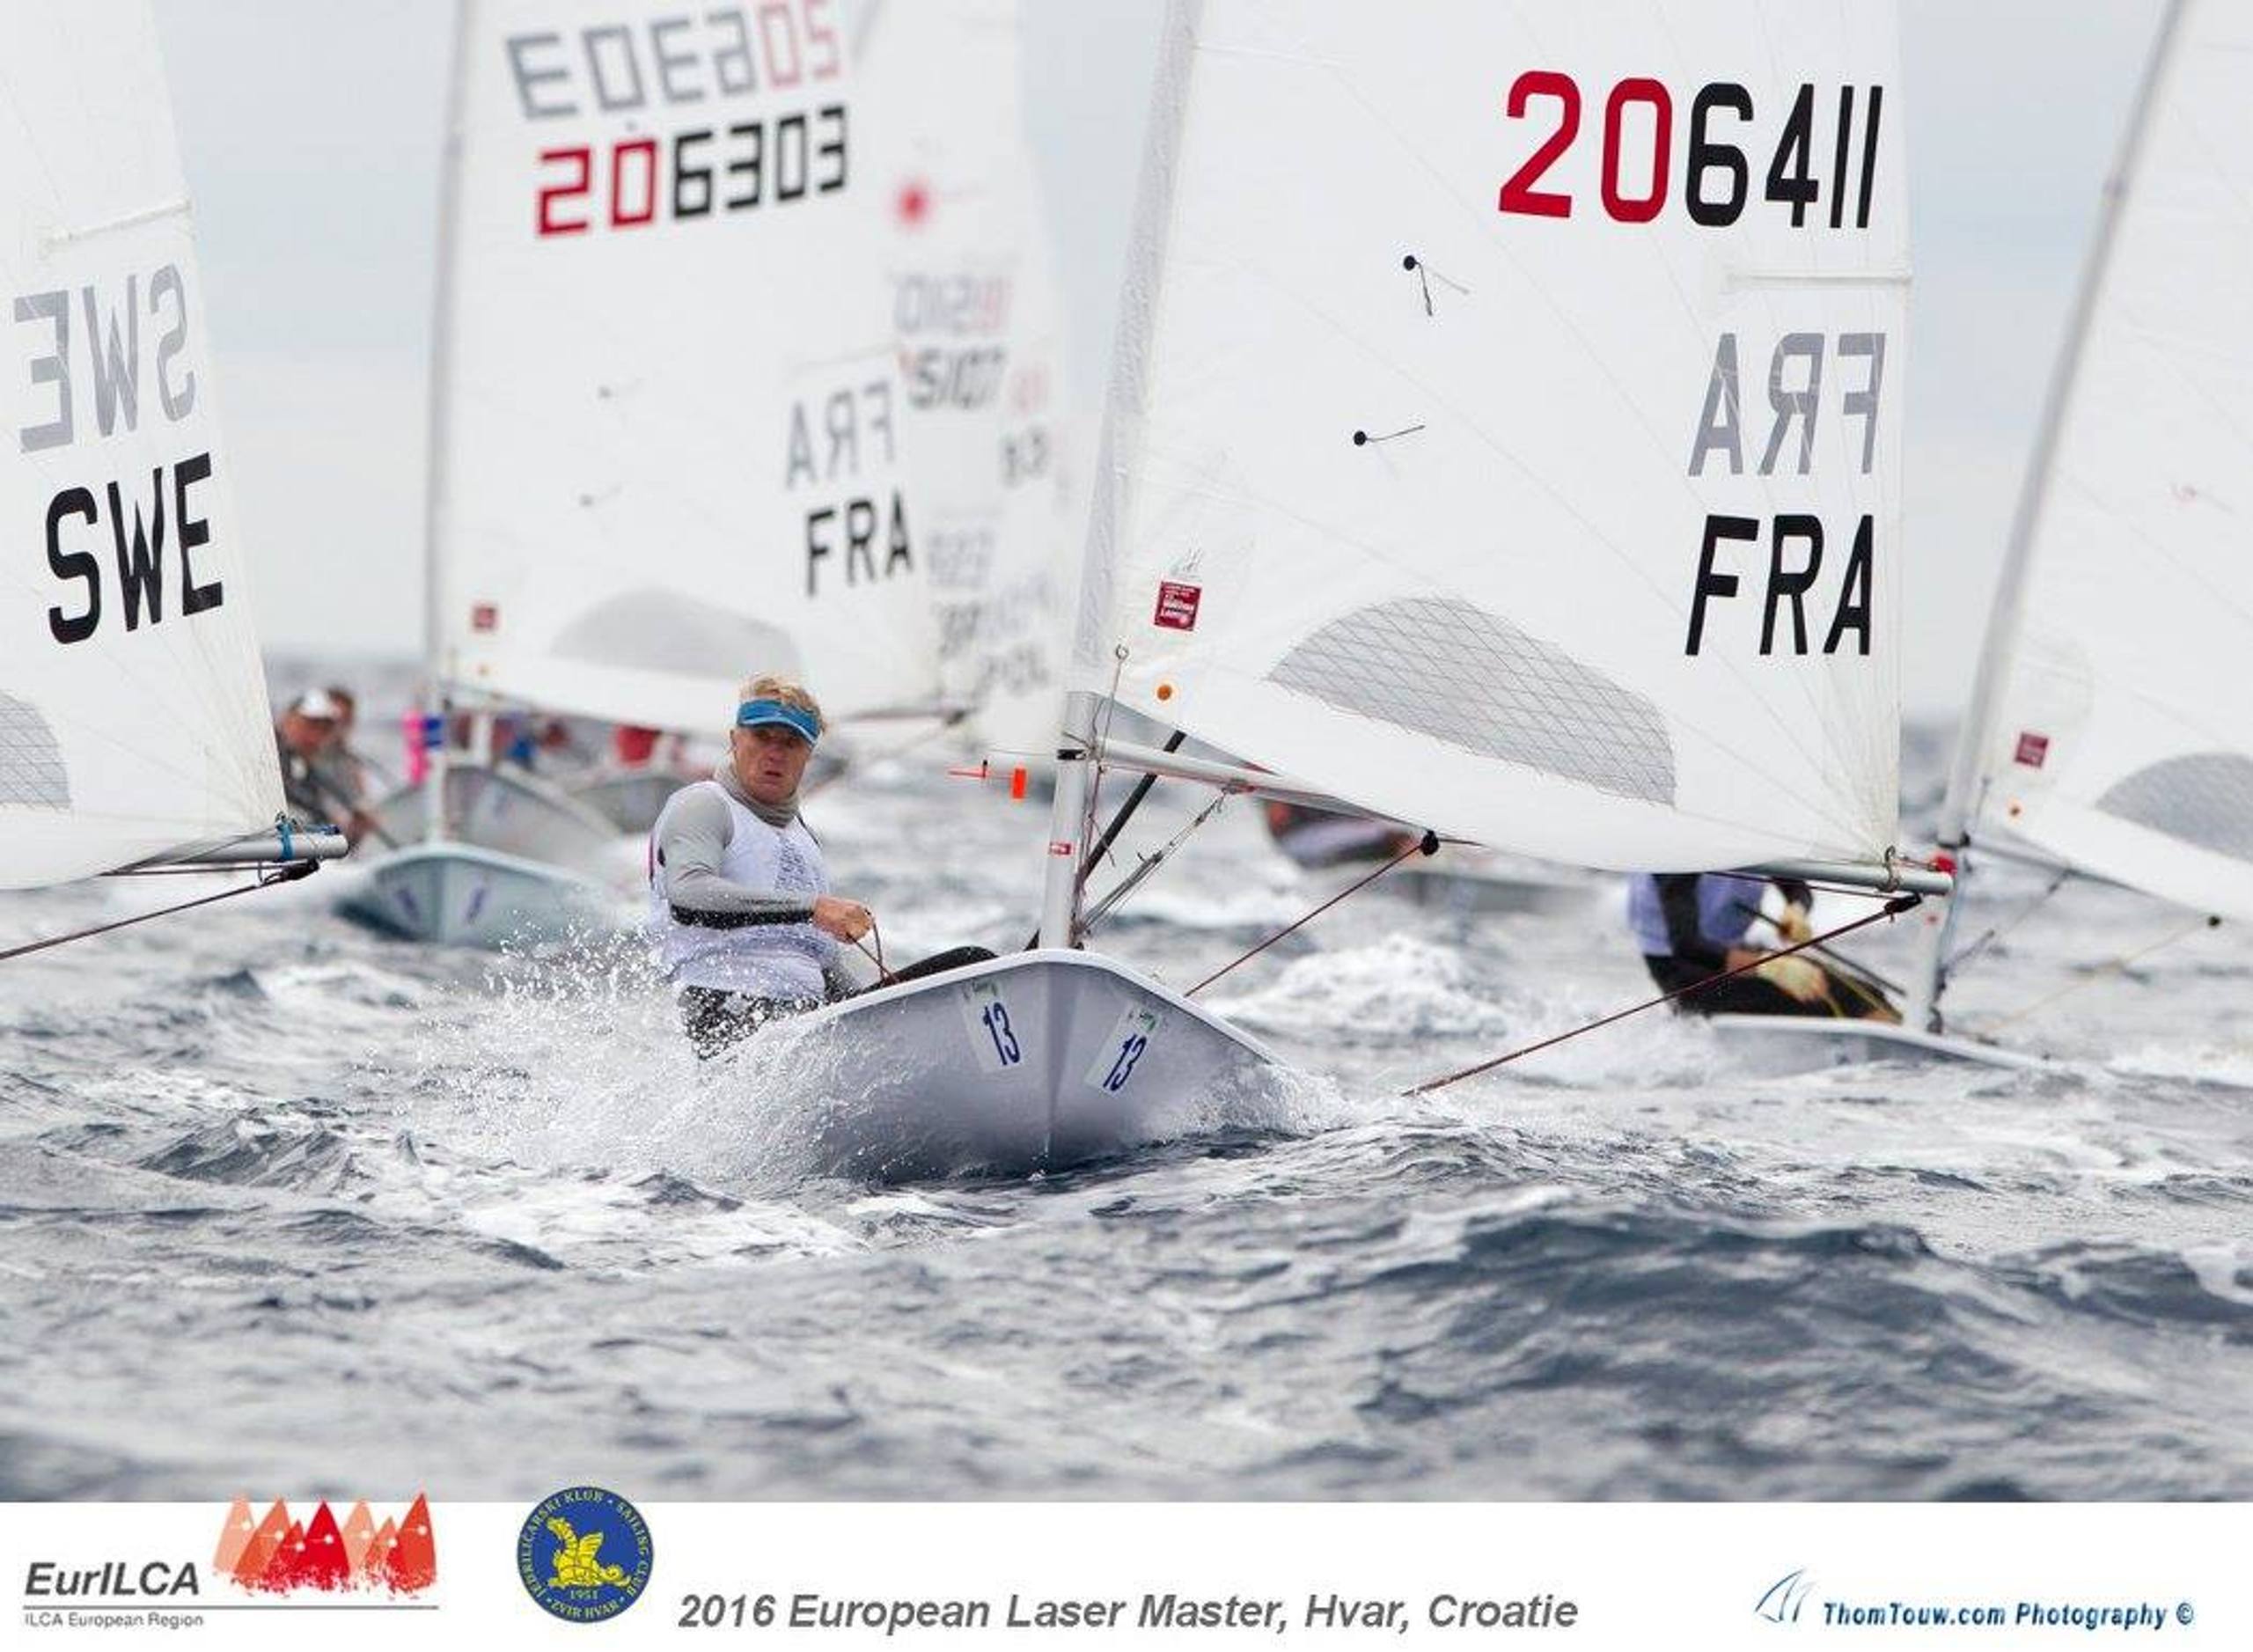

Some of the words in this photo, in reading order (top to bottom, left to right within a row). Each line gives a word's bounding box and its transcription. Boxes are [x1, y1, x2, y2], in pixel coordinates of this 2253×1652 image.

[537, 105, 848, 238] 206303
[1499, 70, 1883, 228] 206411
[46, 452, 224, 644] SWE
[804, 489, 914, 598] FRA
[1684, 514, 1874, 657] FRA
[982, 1002, 1021, 1066] 13
[1102, 1033, 1148, 1092] 13
